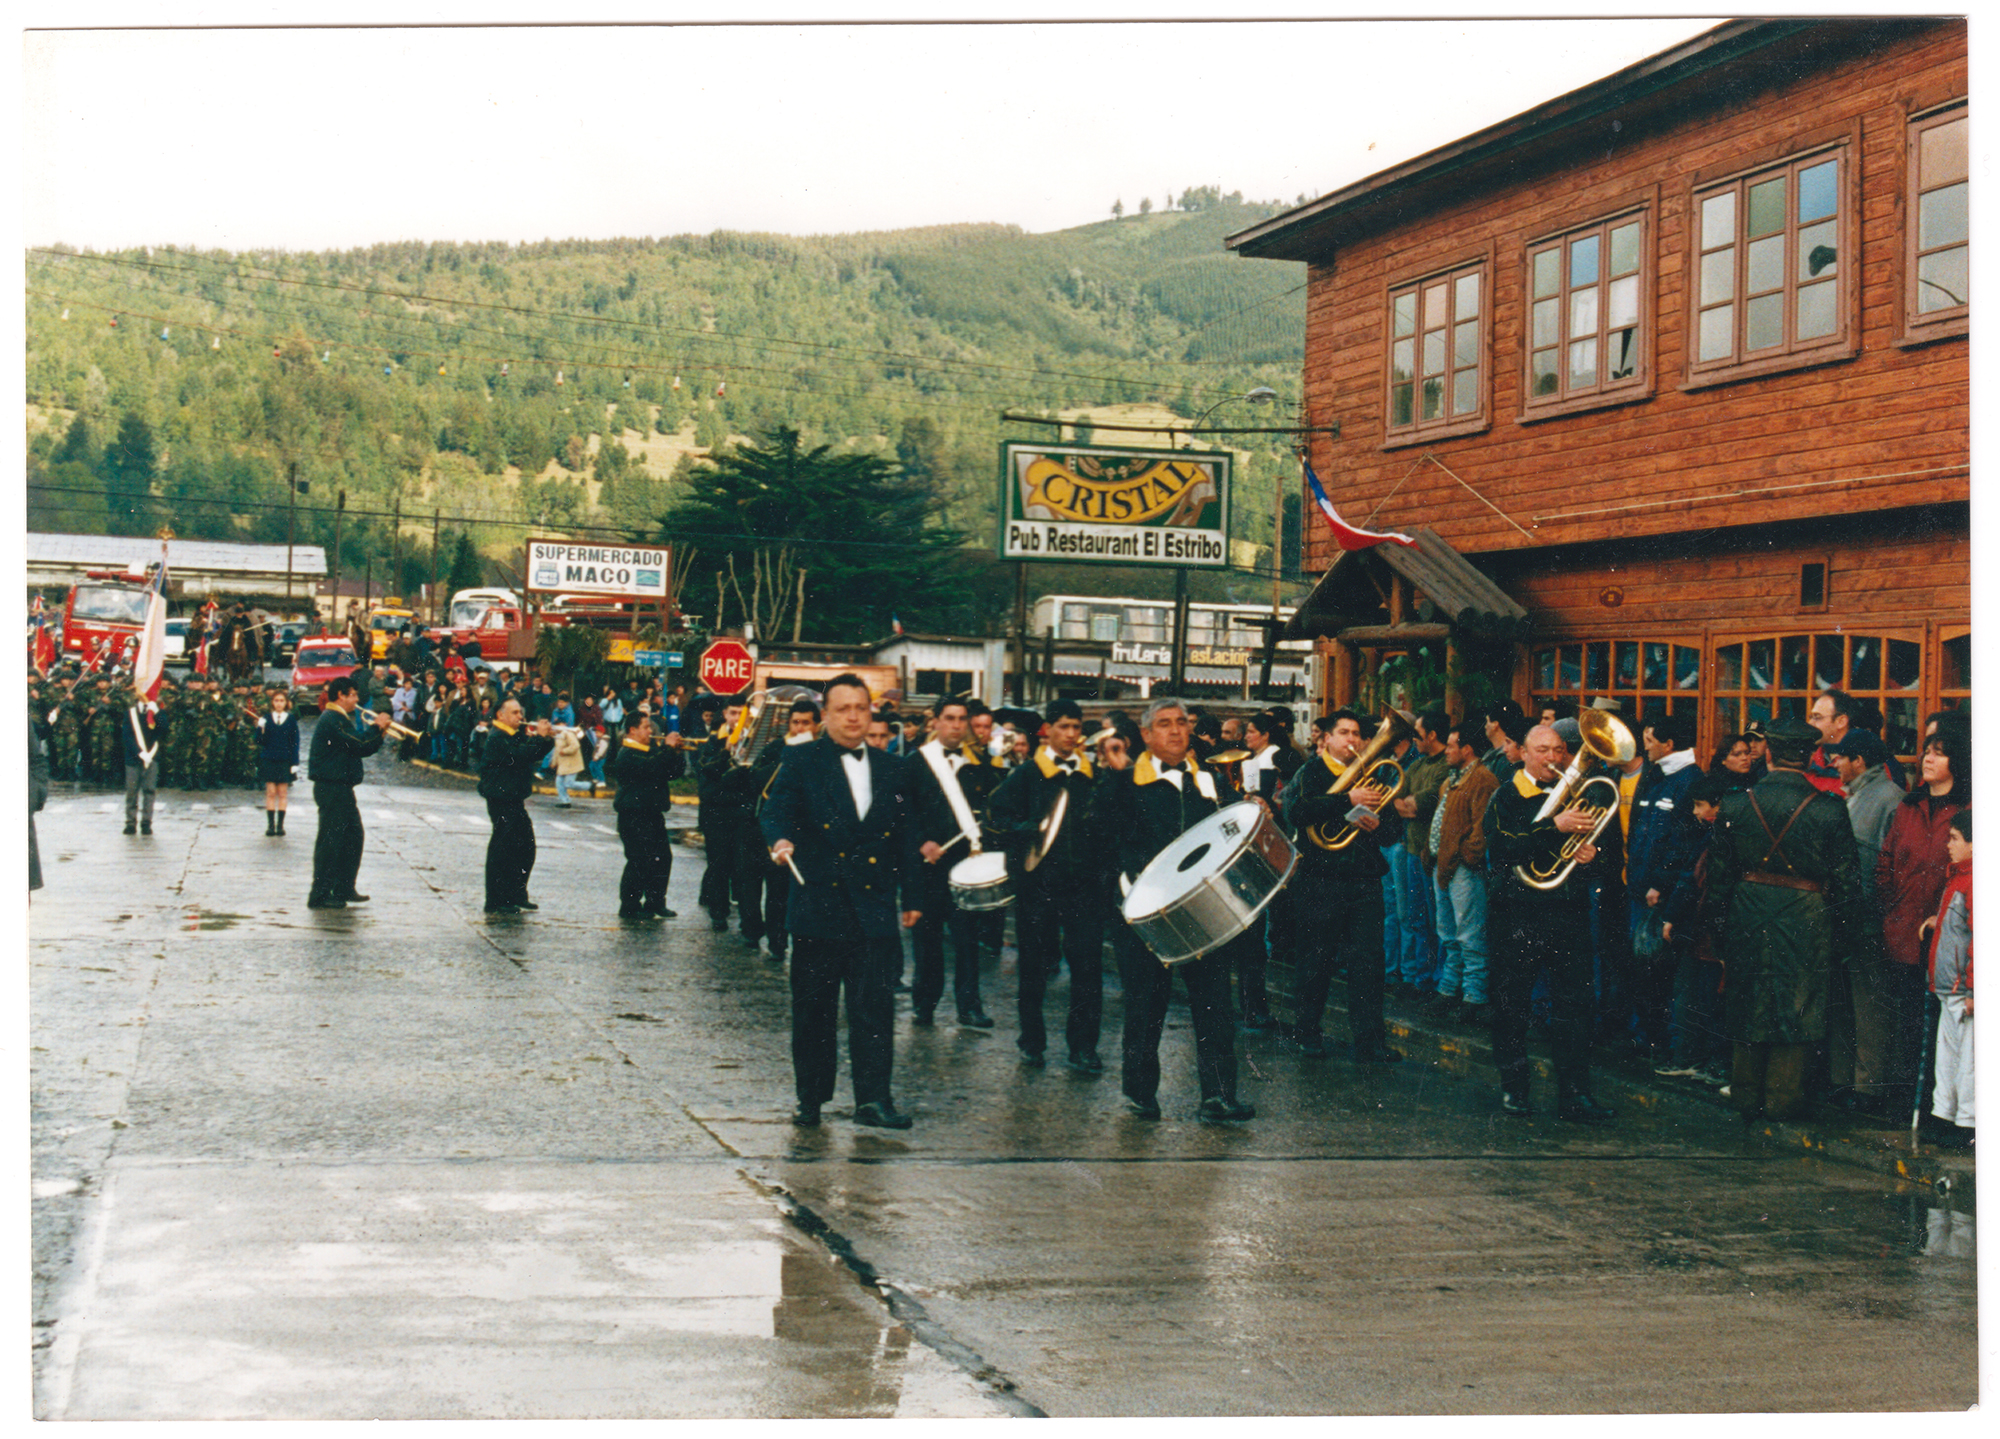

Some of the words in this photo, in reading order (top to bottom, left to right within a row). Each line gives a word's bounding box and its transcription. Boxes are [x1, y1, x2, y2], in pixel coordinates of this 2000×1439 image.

[1043, 462, 1196, 519] CRISTAL
[1010, 525, 1040, 551] Pub
[1047, 527, 1138, 556] Restaurant
[1144, 531, 1158, 556] El
[1165, 533, 1222, 559] Estribo
[535, 545, 663, 566] SUPERMERCADO
[566, 565, 630, 584] MACO
[1112, 642, 1171, 664] frutería
[704, 657, 750, 679] PARE
